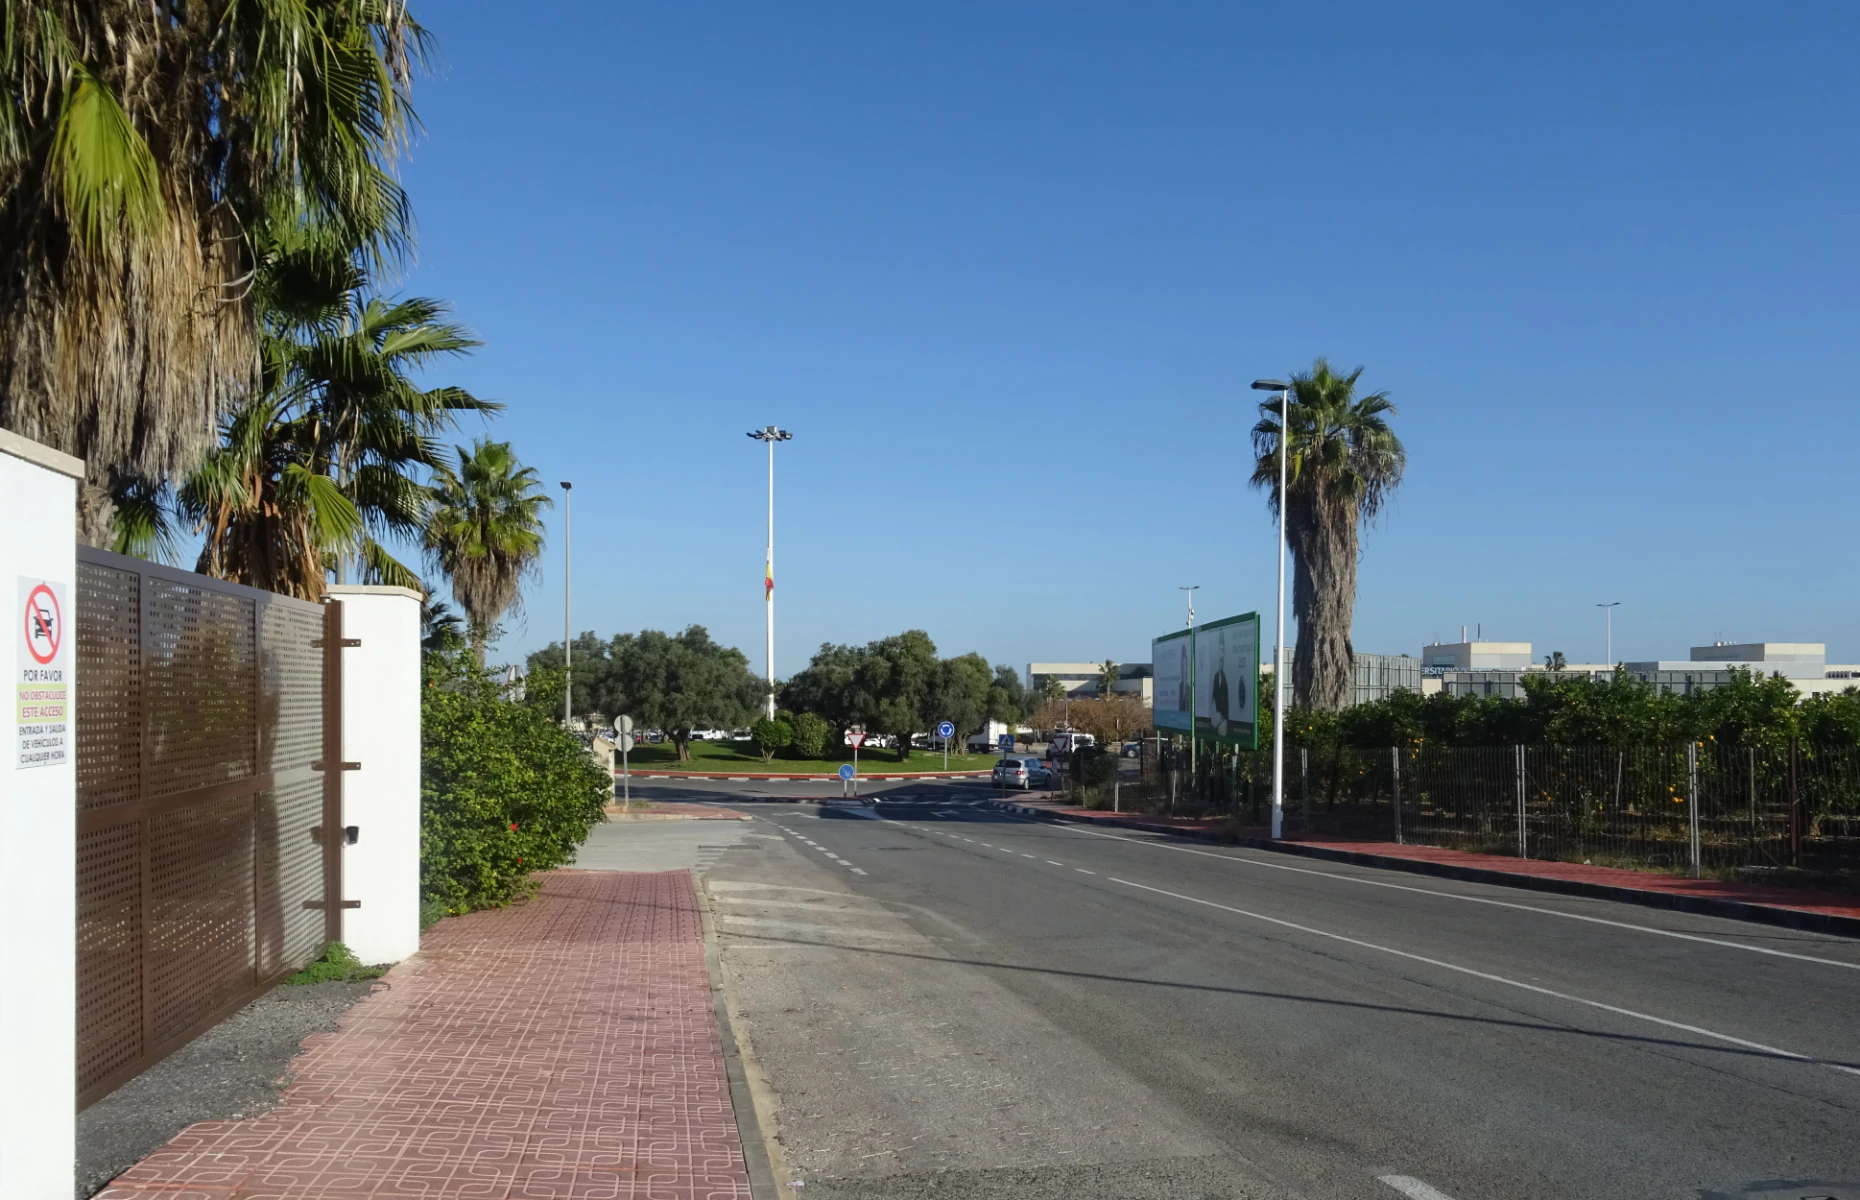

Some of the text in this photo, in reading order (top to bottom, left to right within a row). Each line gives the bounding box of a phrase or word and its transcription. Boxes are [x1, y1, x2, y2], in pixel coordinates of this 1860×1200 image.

[23, 669, 63, 682] POR FAVOR
[19, 690, 66, 701] NO OBSTACULICE
[22, 706, 63, 718] ESTE ACCESO
[19, 724, 66, 736] ENTRADA Y SALIDA
[22, 740, 30, 750] DE
[31, 737, 59, 749] VEHÍCULOS
[20, 750, 65, 763] CUALQUIER HORA
